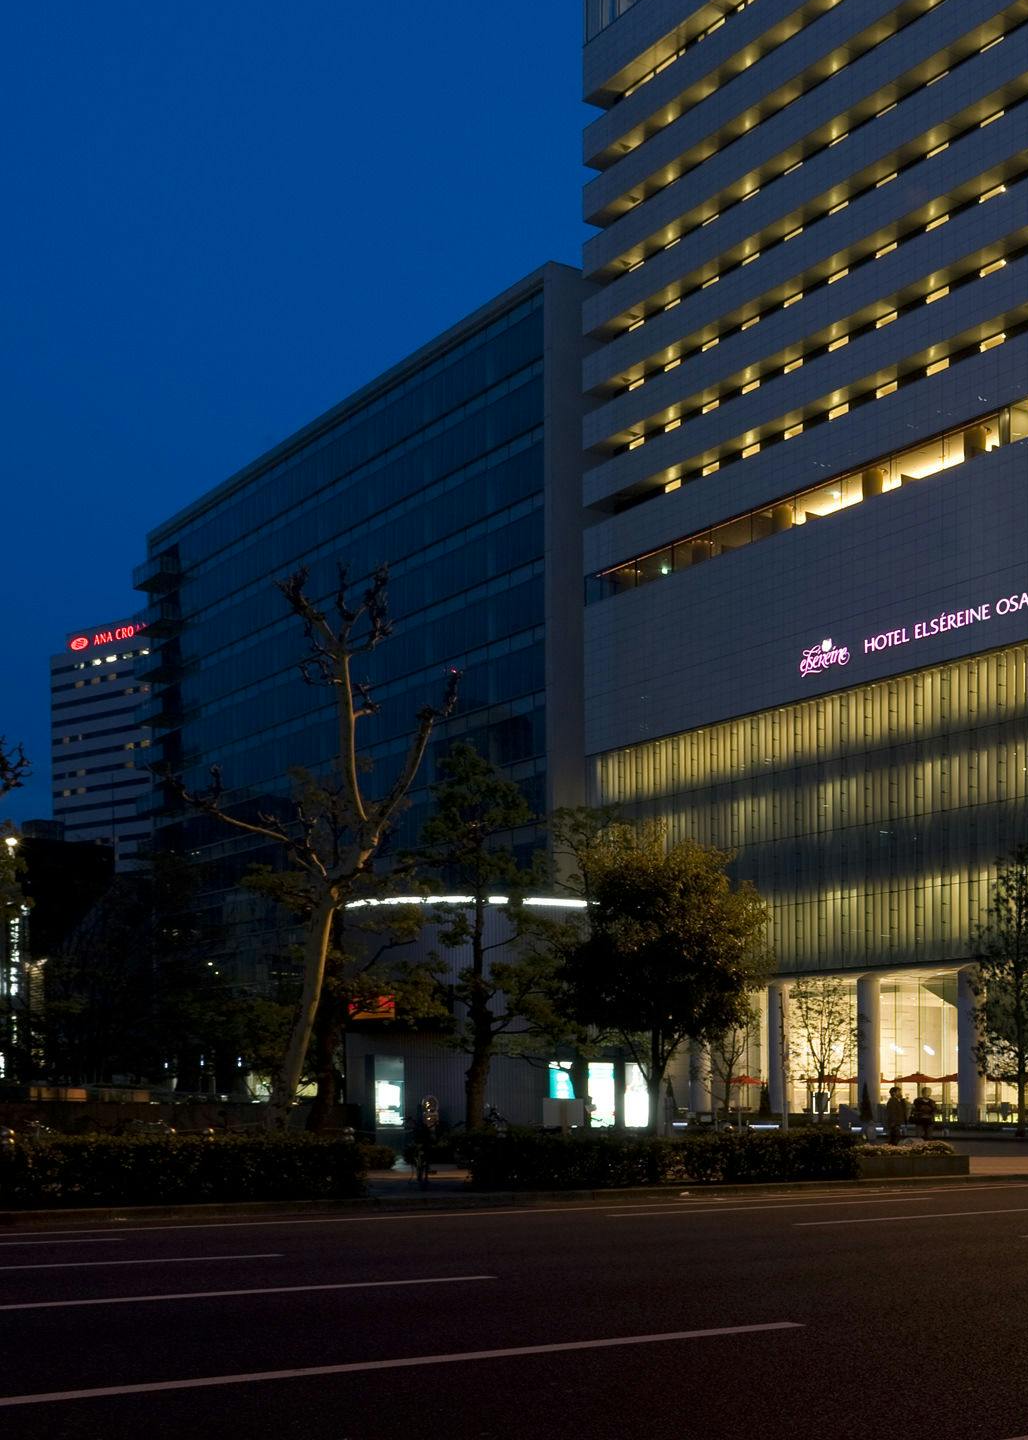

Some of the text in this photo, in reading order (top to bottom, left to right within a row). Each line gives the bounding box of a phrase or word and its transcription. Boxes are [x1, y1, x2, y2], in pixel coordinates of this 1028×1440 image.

[94, 631, 113, 646] ANA
[863, 627, 910, 653] HOTEL
[913, 603, 991, 640] ELSÉREINE
